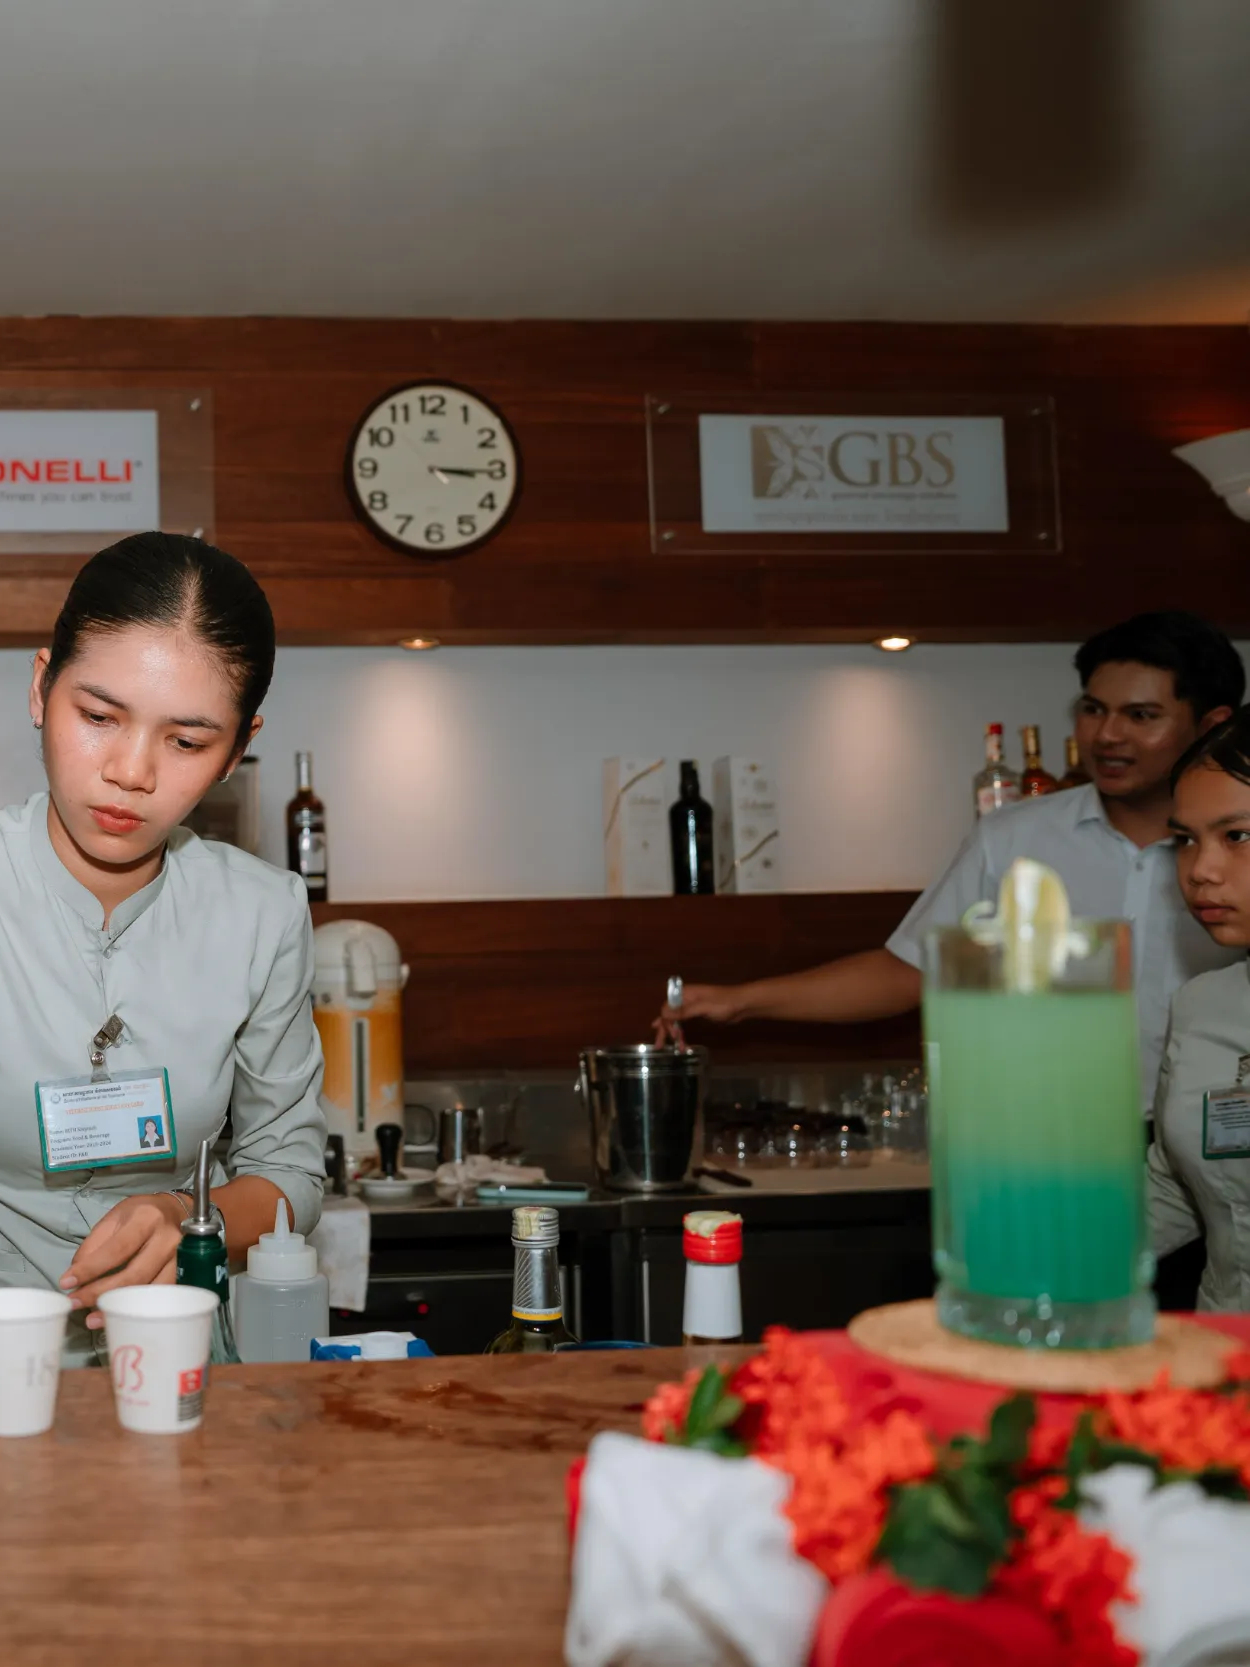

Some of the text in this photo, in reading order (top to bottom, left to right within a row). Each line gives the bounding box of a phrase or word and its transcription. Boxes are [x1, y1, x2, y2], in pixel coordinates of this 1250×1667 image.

[389, 403, 410, 424] 11
[418, 394, 446, 416] 12
[460, 404, 469, 425] 1
[367, 426, 395, 448] 10
[476, 427, 497, 449] 2
[358, 457, 378, 479] 9
[487, 459, 507, 480] 3
[827, 430, 956, 488] GBS
[368, 490, 388, 511] 8
[477, 491, 497, 512] 4
[394, 514, 414, 535] 7
[424, 522, 445, 544] 6
[457, 514, 477, 536] 5
